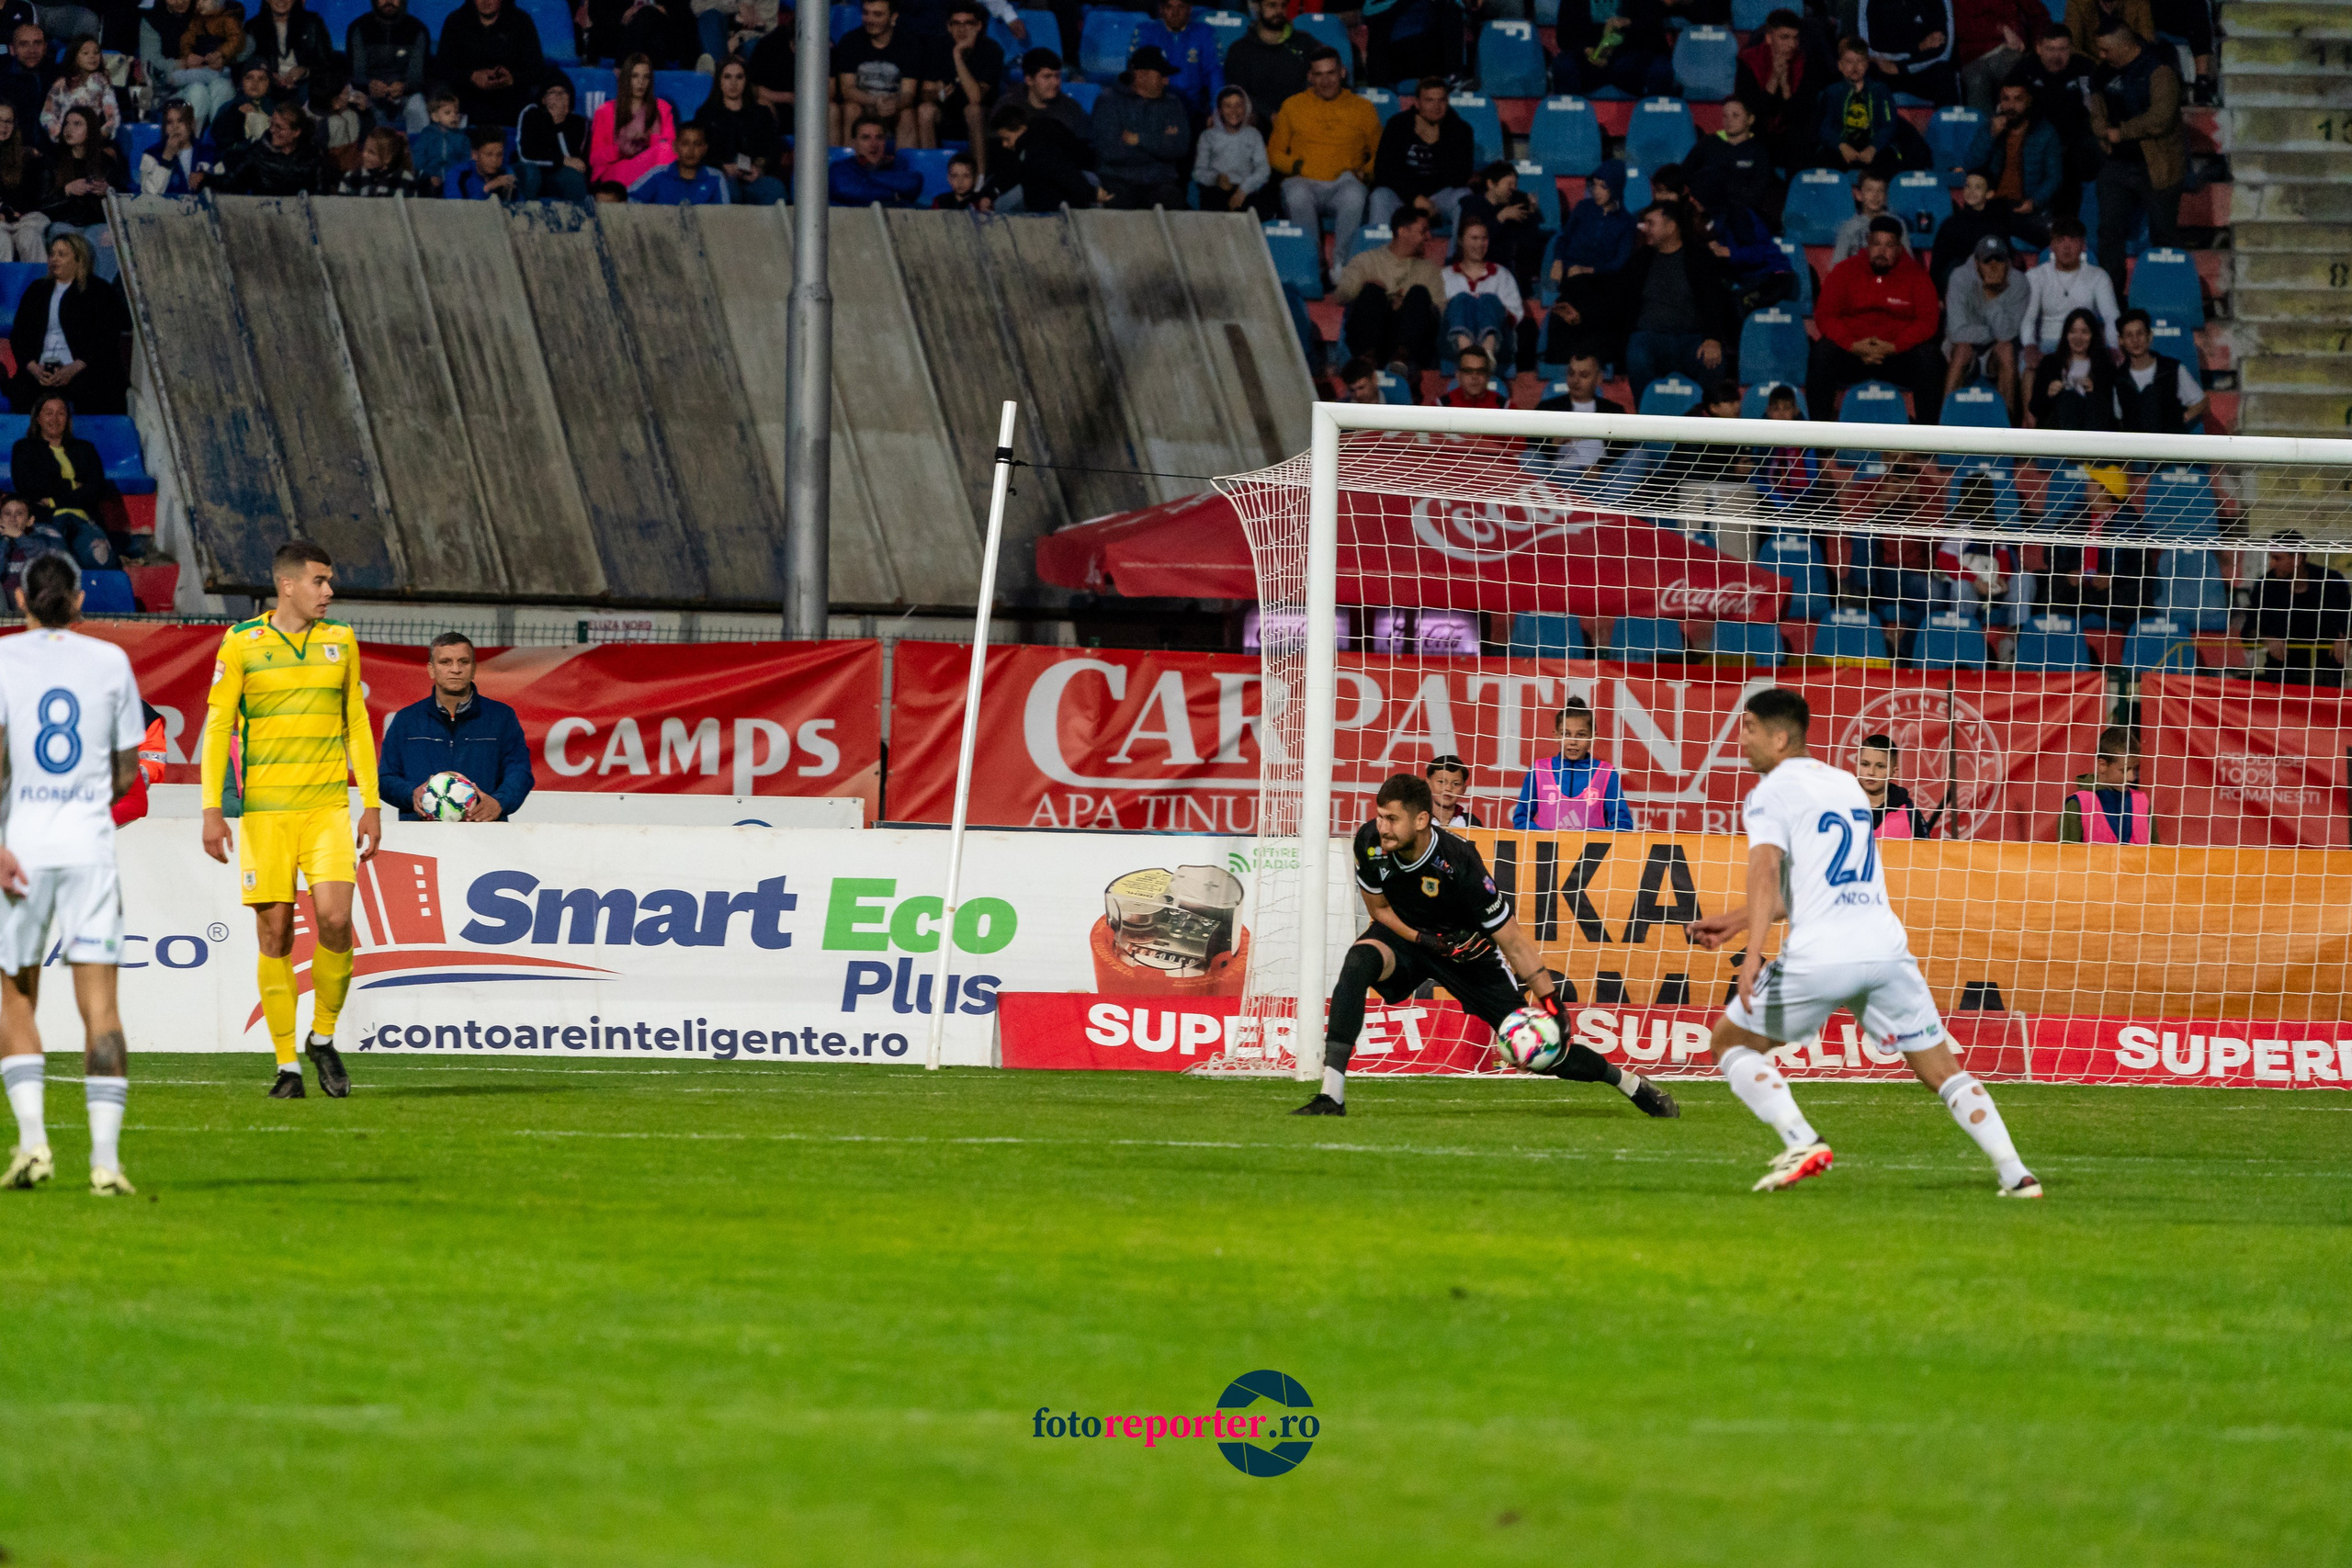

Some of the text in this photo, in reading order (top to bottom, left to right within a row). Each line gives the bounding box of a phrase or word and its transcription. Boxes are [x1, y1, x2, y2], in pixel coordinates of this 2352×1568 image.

[35, 687, 83, 773] 8
[544, 716, 840, 795] CAMPS
[1024, 658, 1776, 801] CARPATNA
[2220, 766, 2278, 785] 100%
[1028, 794, 1123, 829] APA
[1817, 808, 1876, 887] 27
[459, 869, 1019, 955] Smart Eco
[841, 956, 1003, 1016] Plus
[377, 1015, 909, 1060] contoareinteligente.ro
[1085, 1002, 1429, 1058] SUPERET
